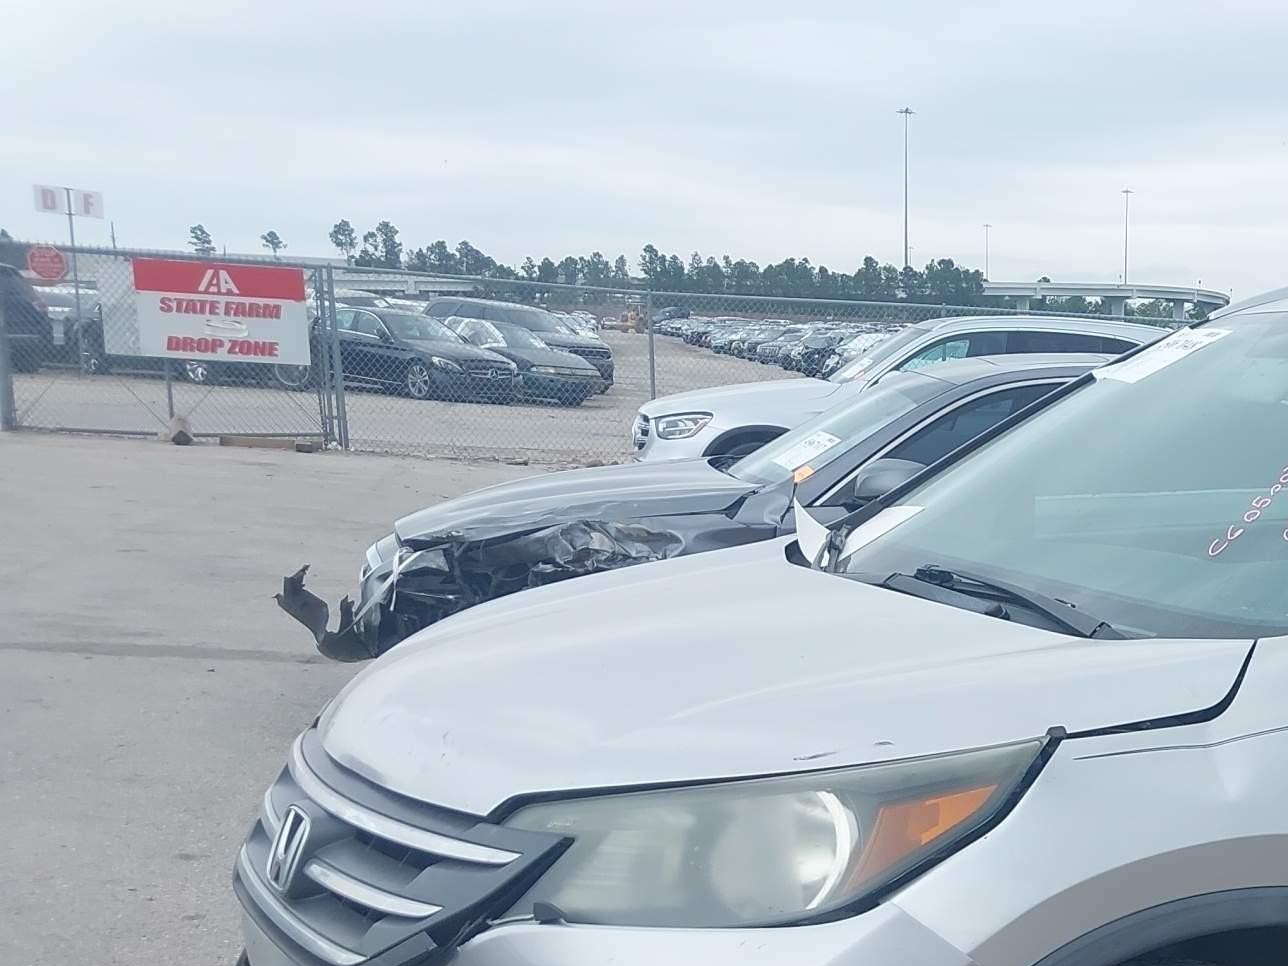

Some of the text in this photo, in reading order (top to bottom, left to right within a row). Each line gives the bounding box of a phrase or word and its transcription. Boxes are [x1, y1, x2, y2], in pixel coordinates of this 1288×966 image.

[83, 193, 94, 214] F
[159, 296, 282, 320] STATE FARM
[166, 335, 280, 357] DROP ZONE
